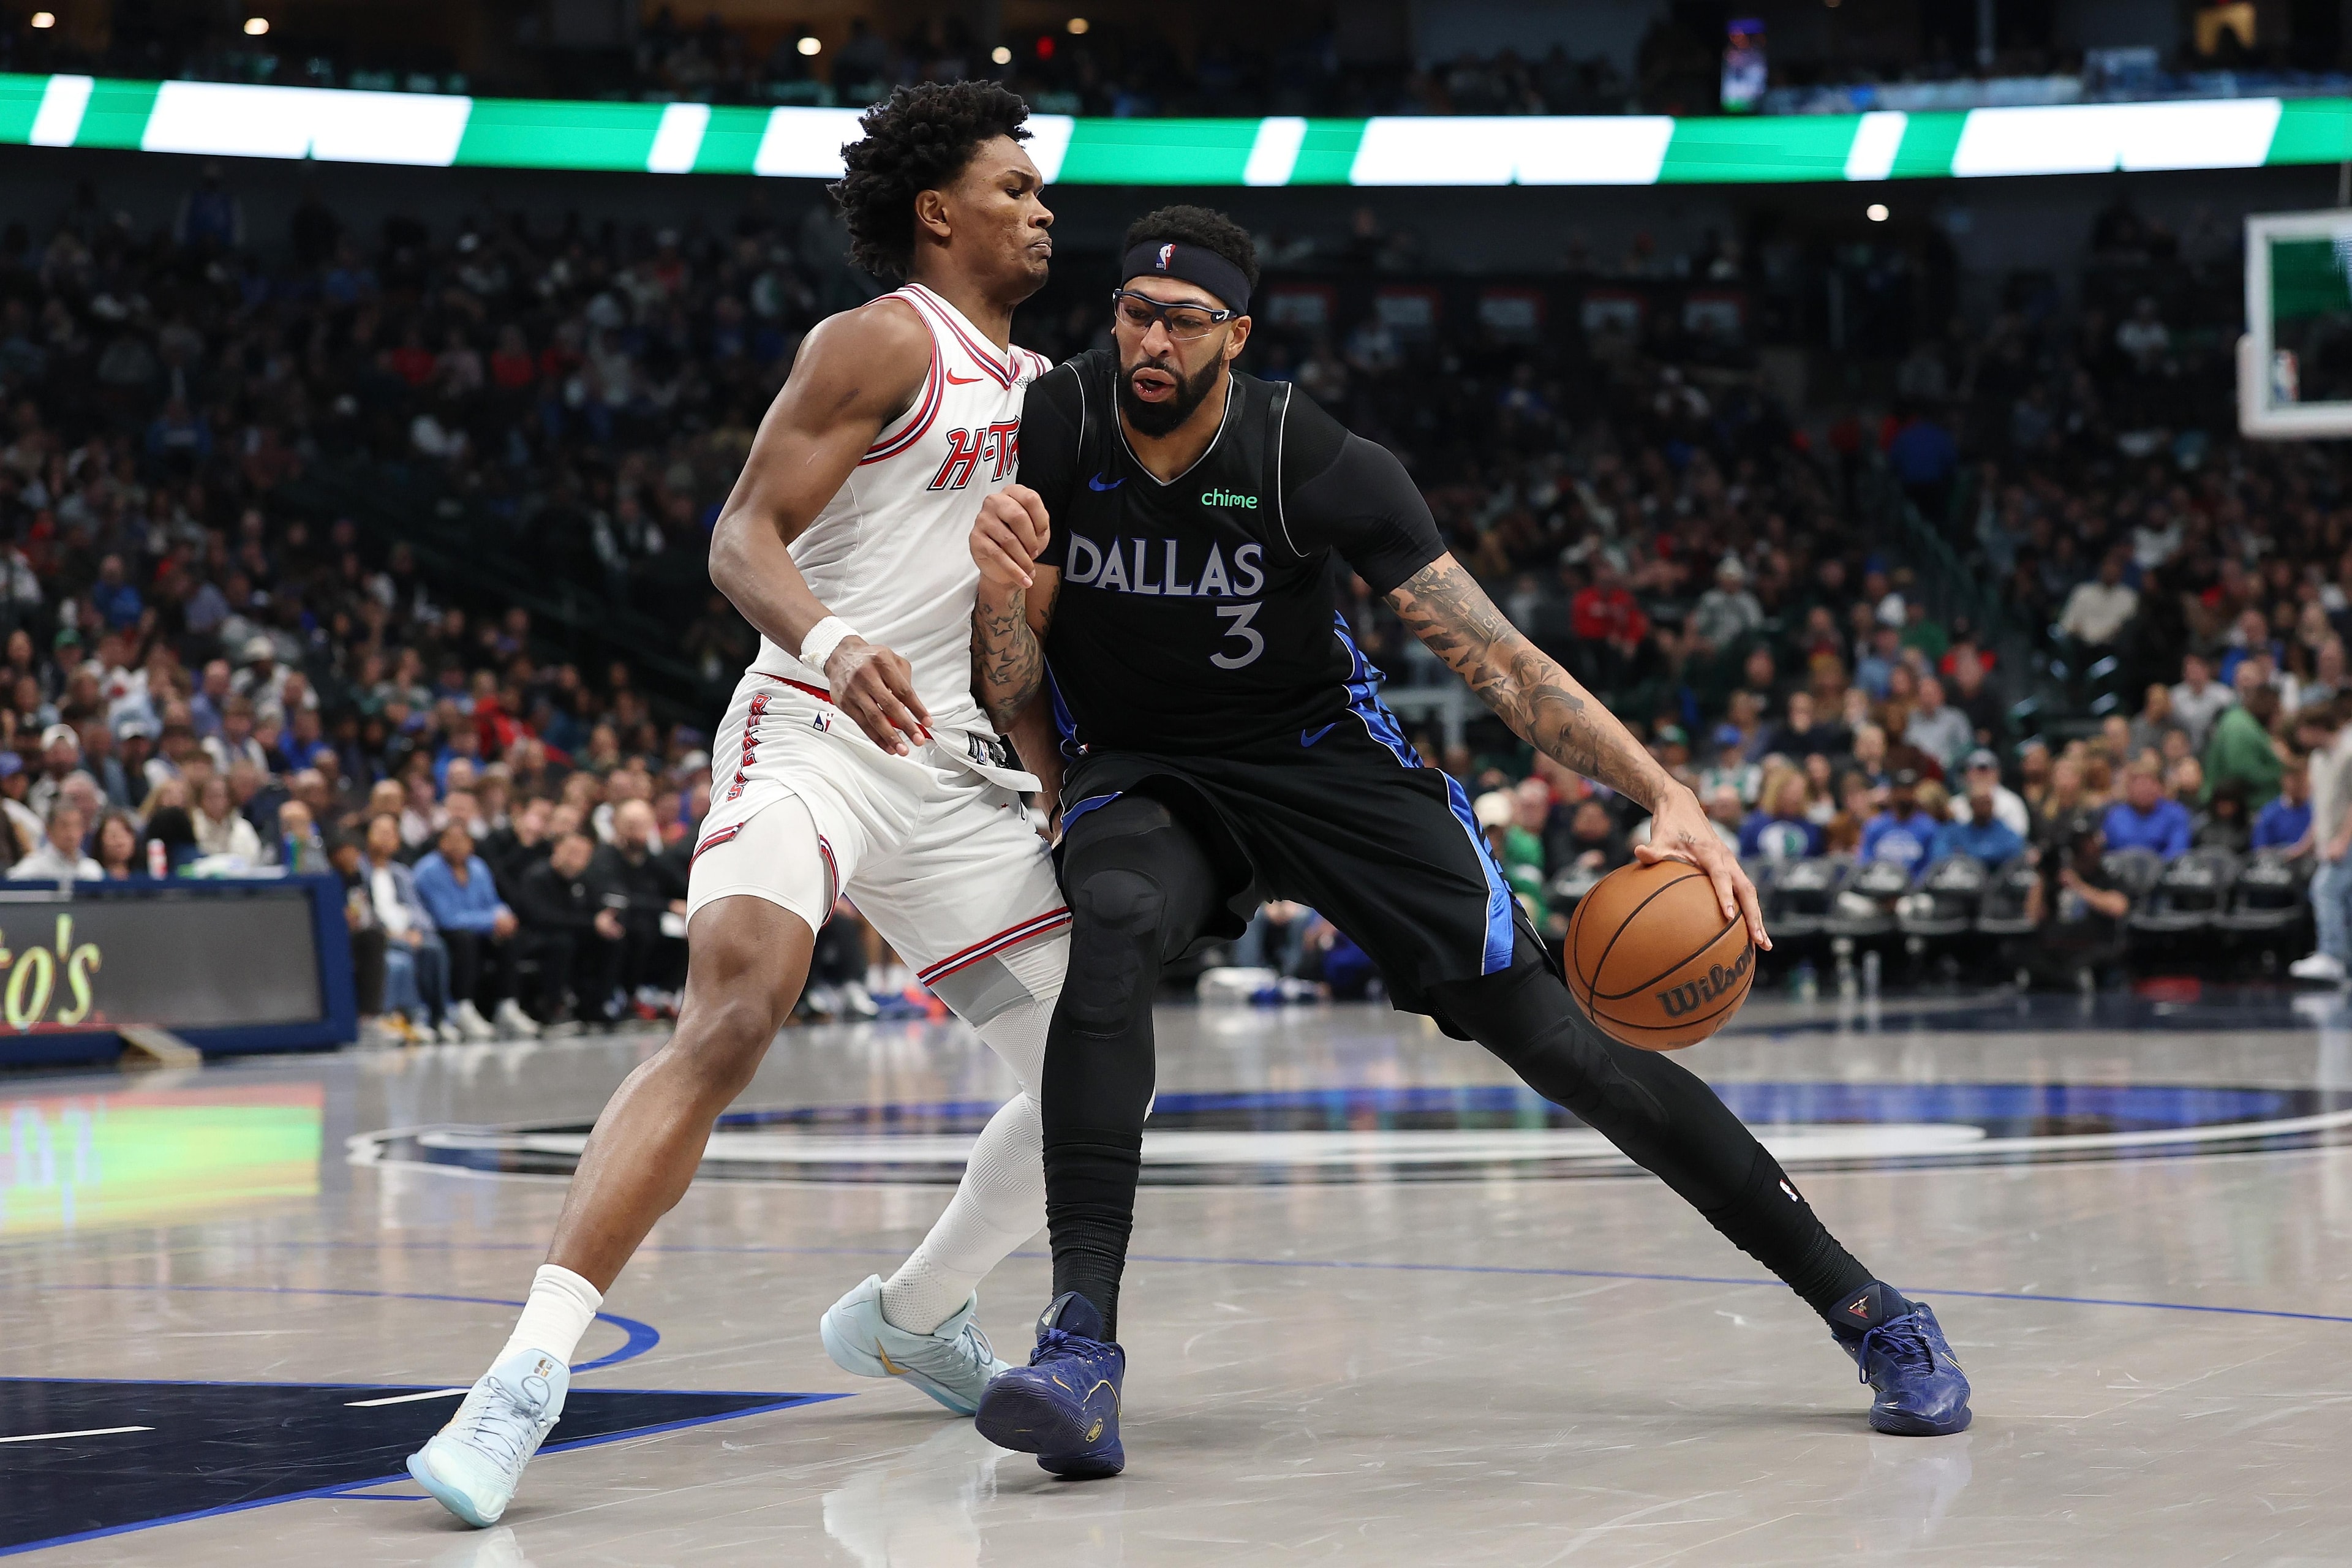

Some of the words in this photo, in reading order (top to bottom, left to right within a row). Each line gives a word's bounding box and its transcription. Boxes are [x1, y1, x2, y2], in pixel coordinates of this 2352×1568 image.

[1201, 488, 1257, 509] chime
[1065, 529, 1264, 597] DALLAS
[1210, 600, 1264, 669] 3
[0, 913, 102, 1031] o's
[1656, 938, 1755, 1019] Wilson
